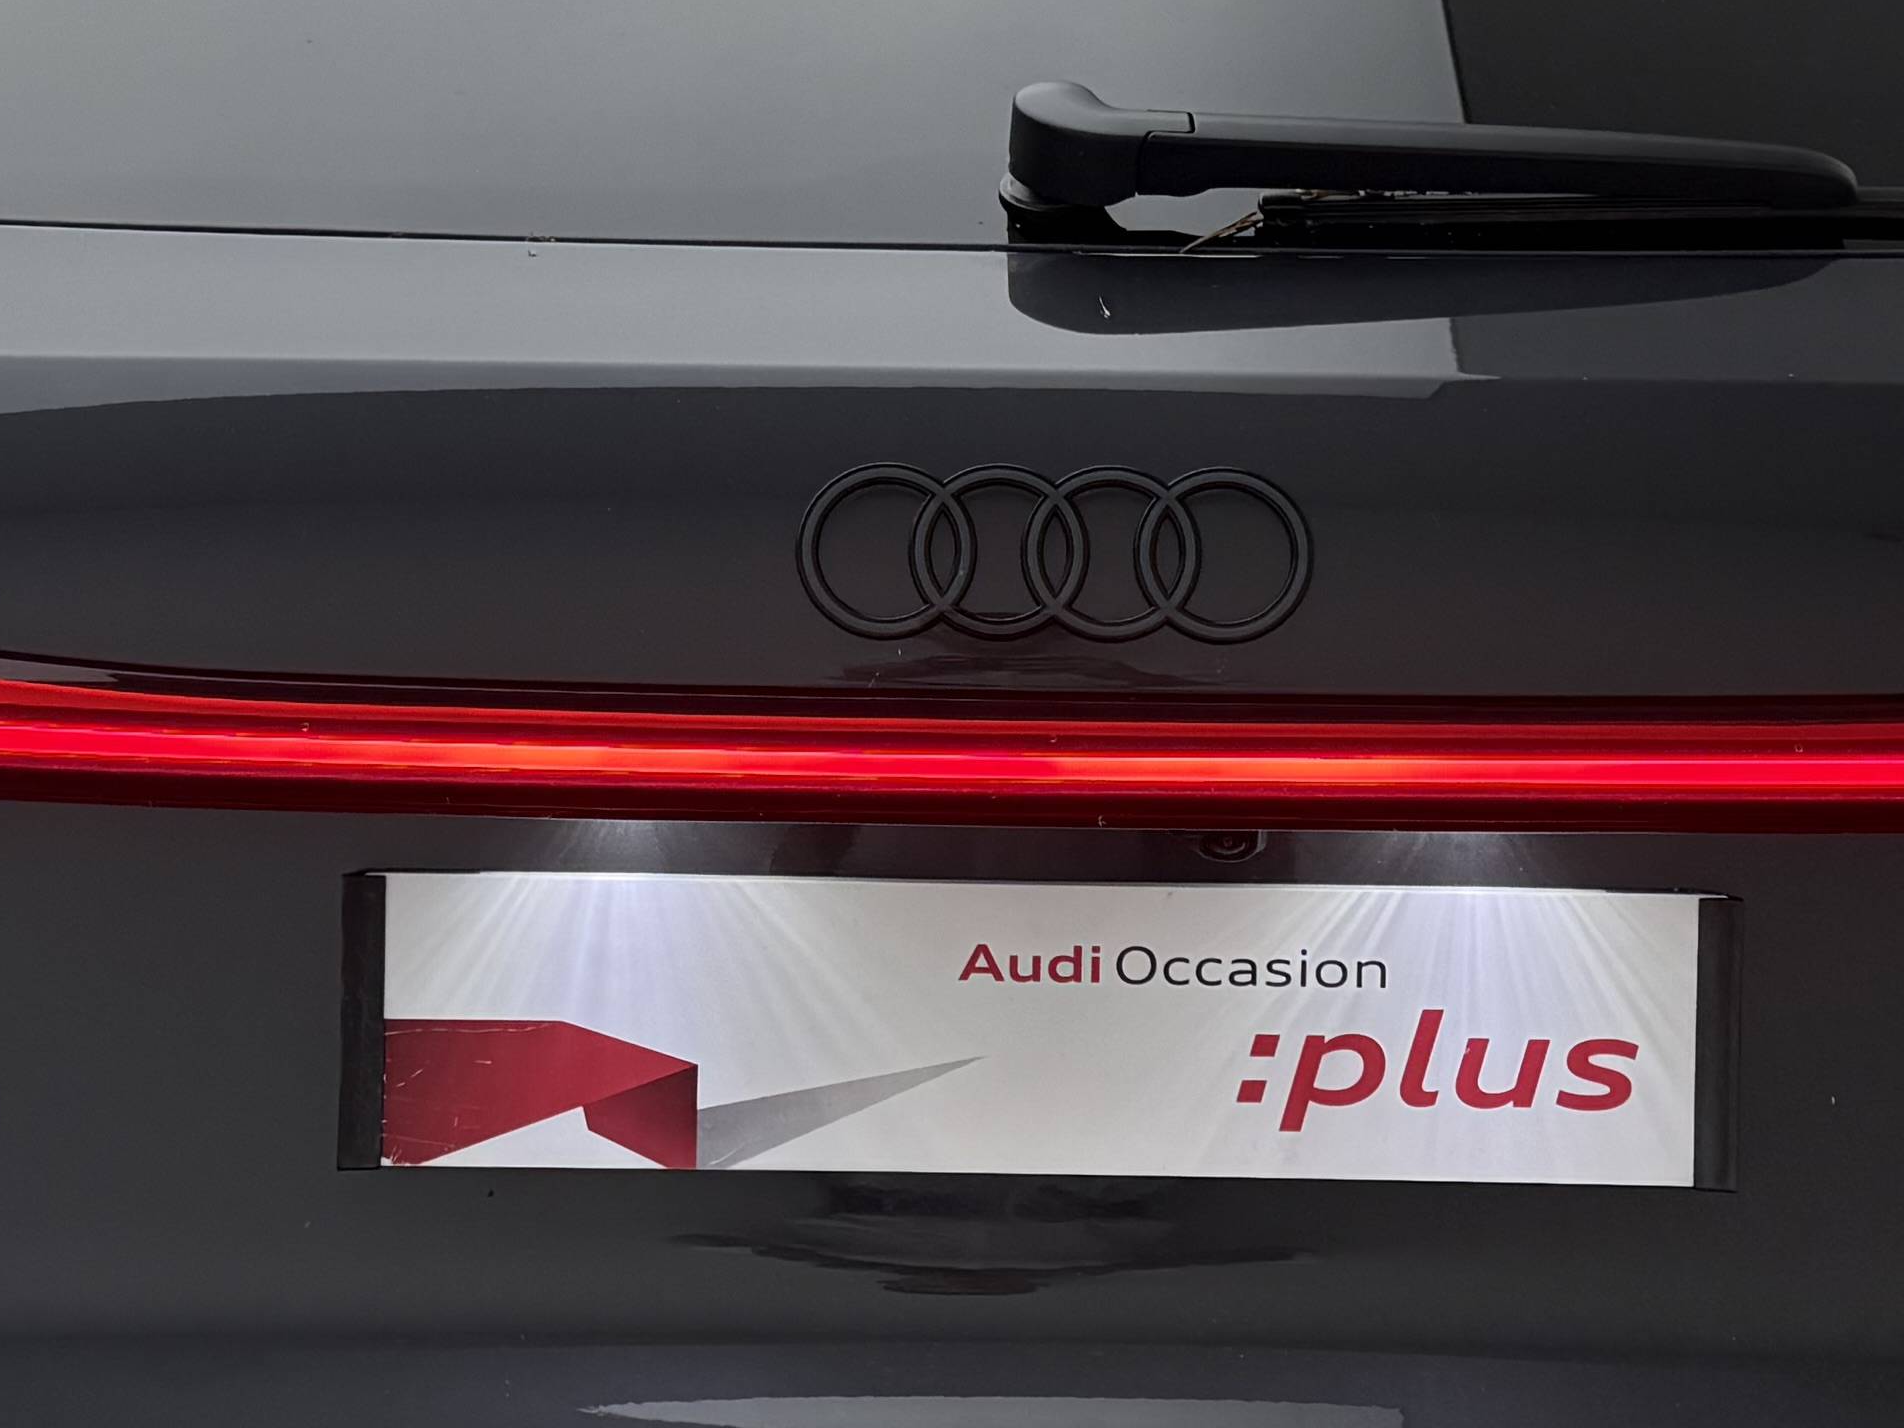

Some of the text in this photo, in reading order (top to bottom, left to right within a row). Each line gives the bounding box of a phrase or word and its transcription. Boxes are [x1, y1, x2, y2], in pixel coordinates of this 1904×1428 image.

[957, 943, 1387, 989] Audi Occasion
[1236, 1008, 1640, 1132] :plus
